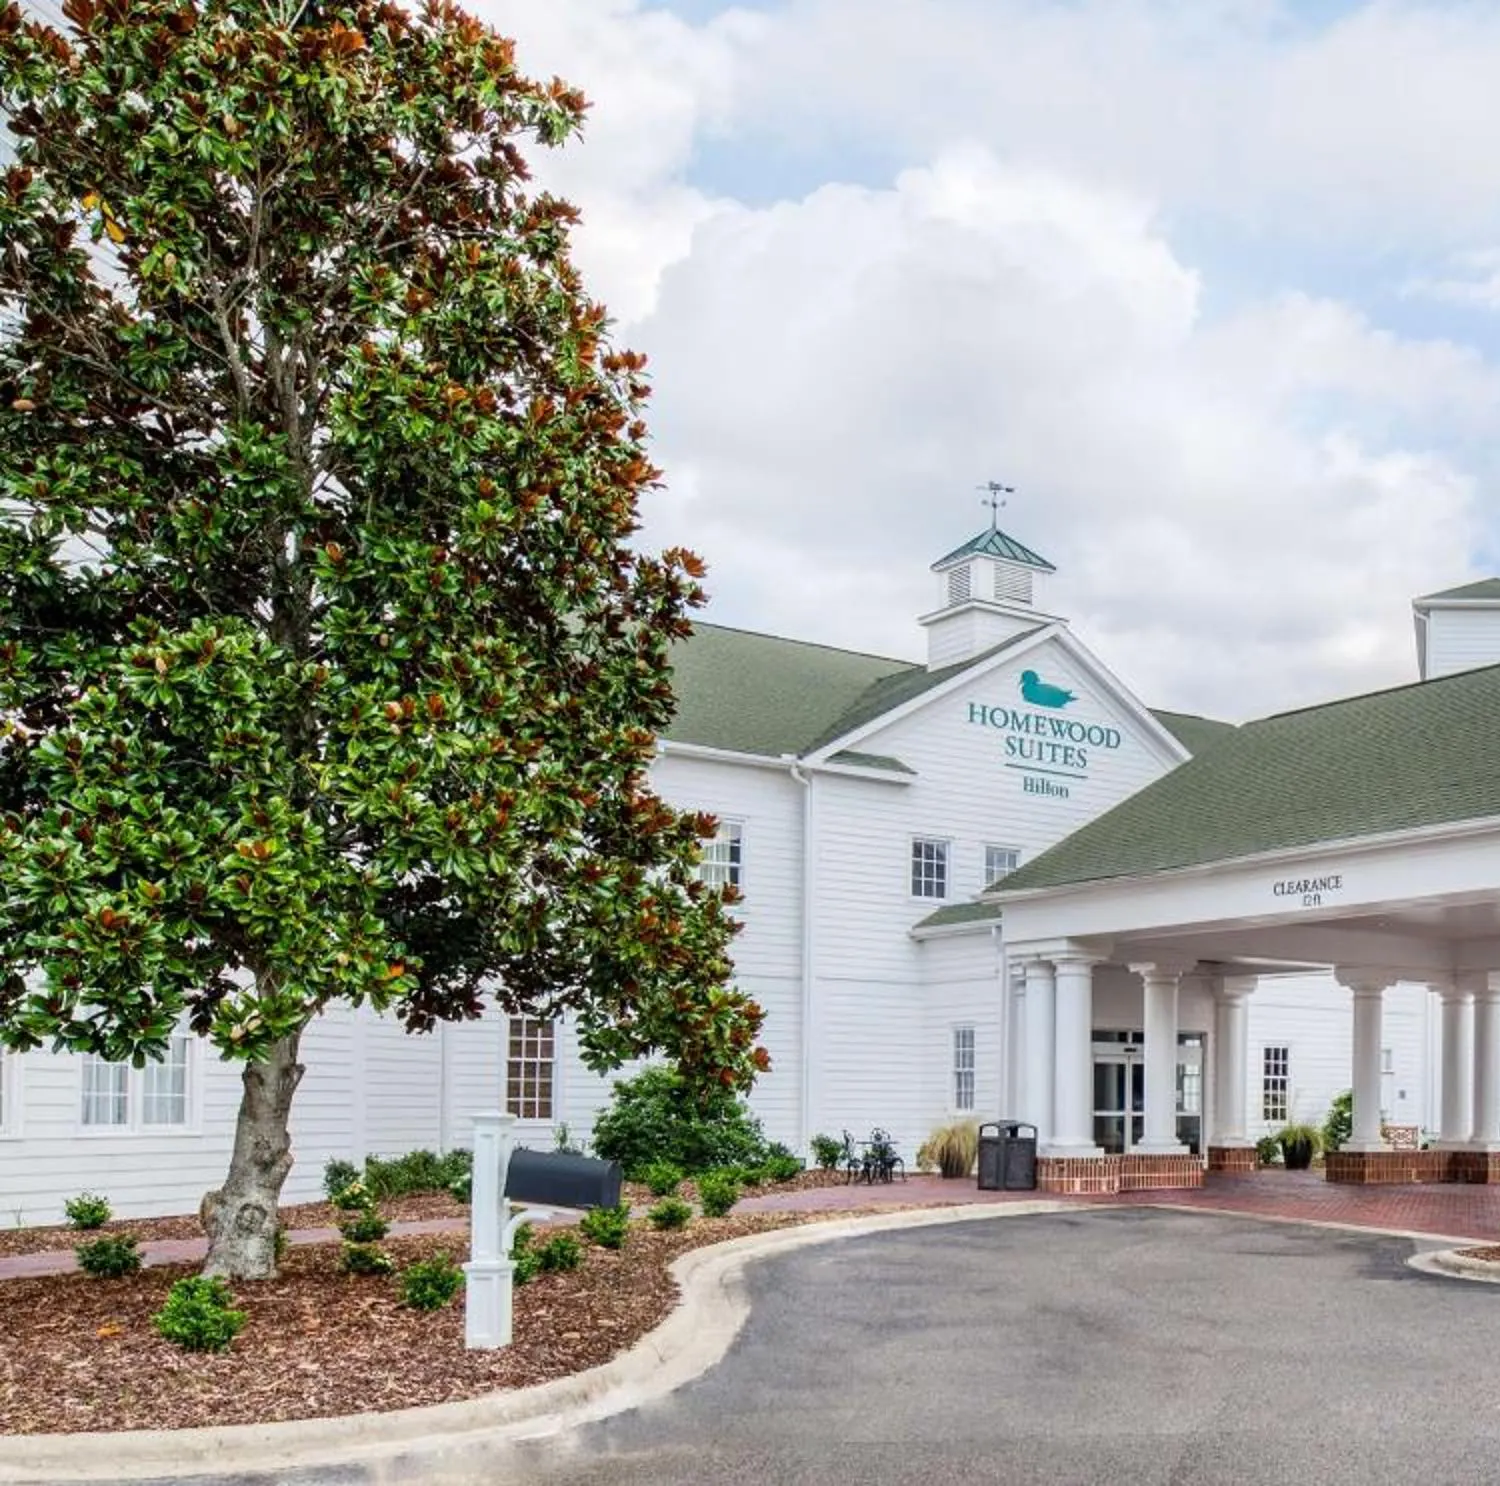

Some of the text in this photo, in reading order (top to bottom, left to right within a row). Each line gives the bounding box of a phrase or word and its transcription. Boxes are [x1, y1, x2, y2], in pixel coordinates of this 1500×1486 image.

[968, 703, 1121, 749] HOMEWOOD
[1005, 735, 1087, 768] SUITES
[1023, 775, 1069, 798] Hilton
[1273, 875, 1342, 896] CLEARANCE
